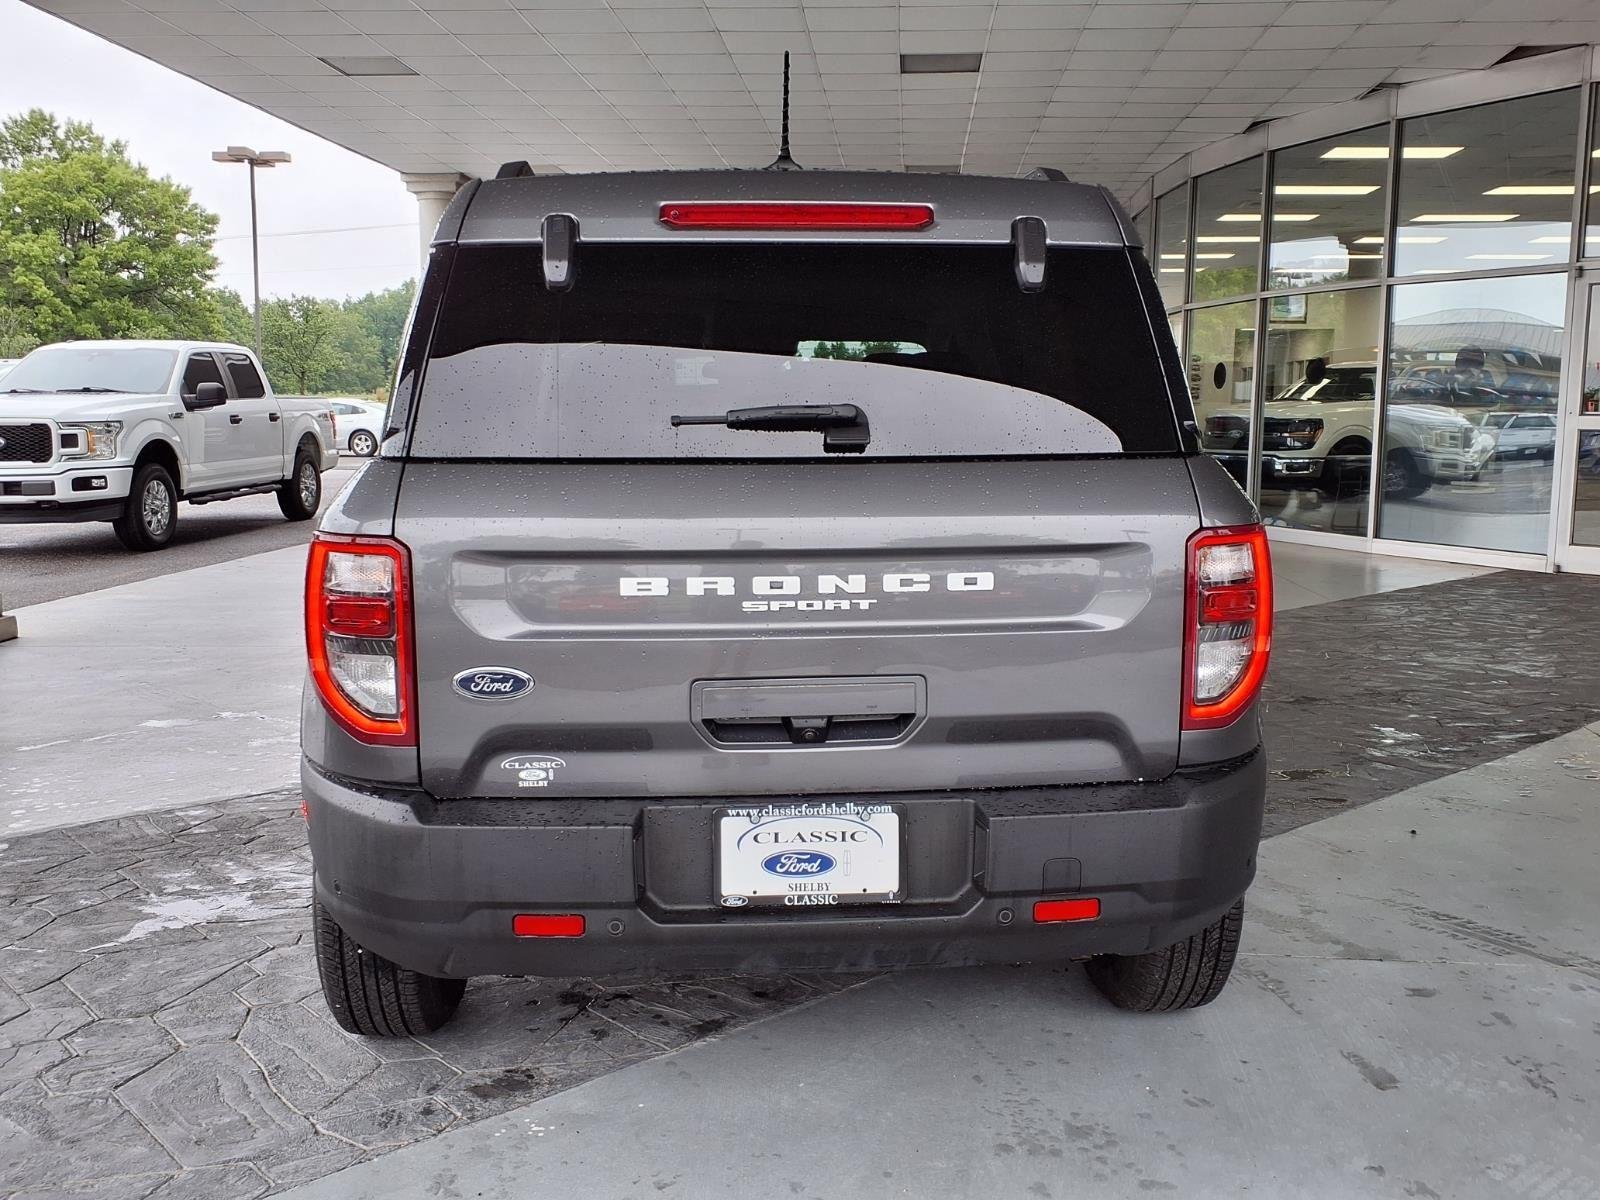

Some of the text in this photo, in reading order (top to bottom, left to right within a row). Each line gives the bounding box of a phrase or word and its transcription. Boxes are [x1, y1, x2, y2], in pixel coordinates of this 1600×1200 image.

[619, 572, 994, 596] BRONCO
[742, 599, 877, 612] SPORT
[470, 673, 514, 692] Ford
[505, 761, 561, 769] CLASSIC
[727, 803, 893, 817] www.classicfordshelby.com
[753, 830, 868, 844] CLASSIC
[776, 853, 821, 873] Ford
[787, 882, 832, 892] SHELBY
[784, 894, 839, 905] CLASSIC
